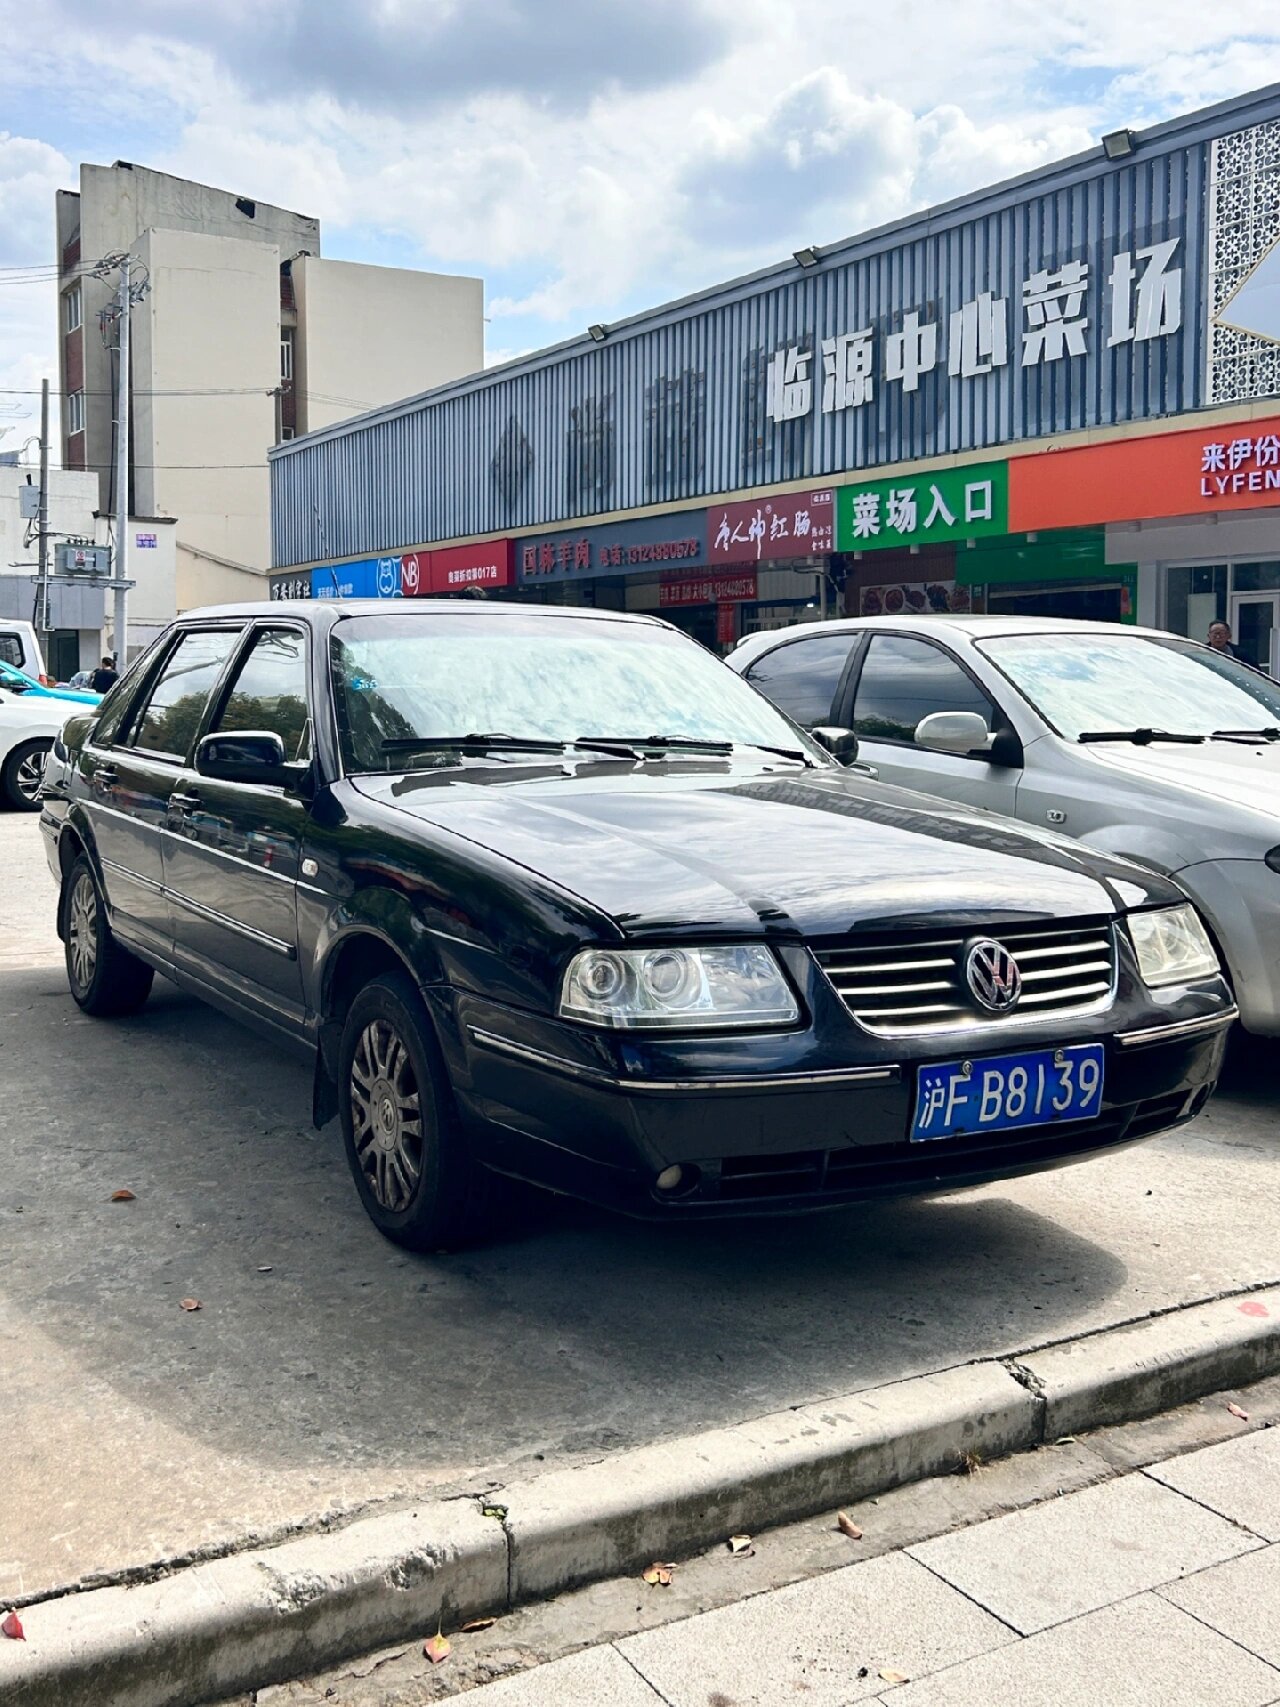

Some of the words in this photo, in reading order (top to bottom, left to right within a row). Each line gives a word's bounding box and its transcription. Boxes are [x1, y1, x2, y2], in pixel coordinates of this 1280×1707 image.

[767, 237, 1182, 422] 临源中心菜场
[1201, 435, 1280, 472] 来伊份
[1201, 470, 1280, 496] LYFEN
[852, 480, 992, 538] 菜场入口
